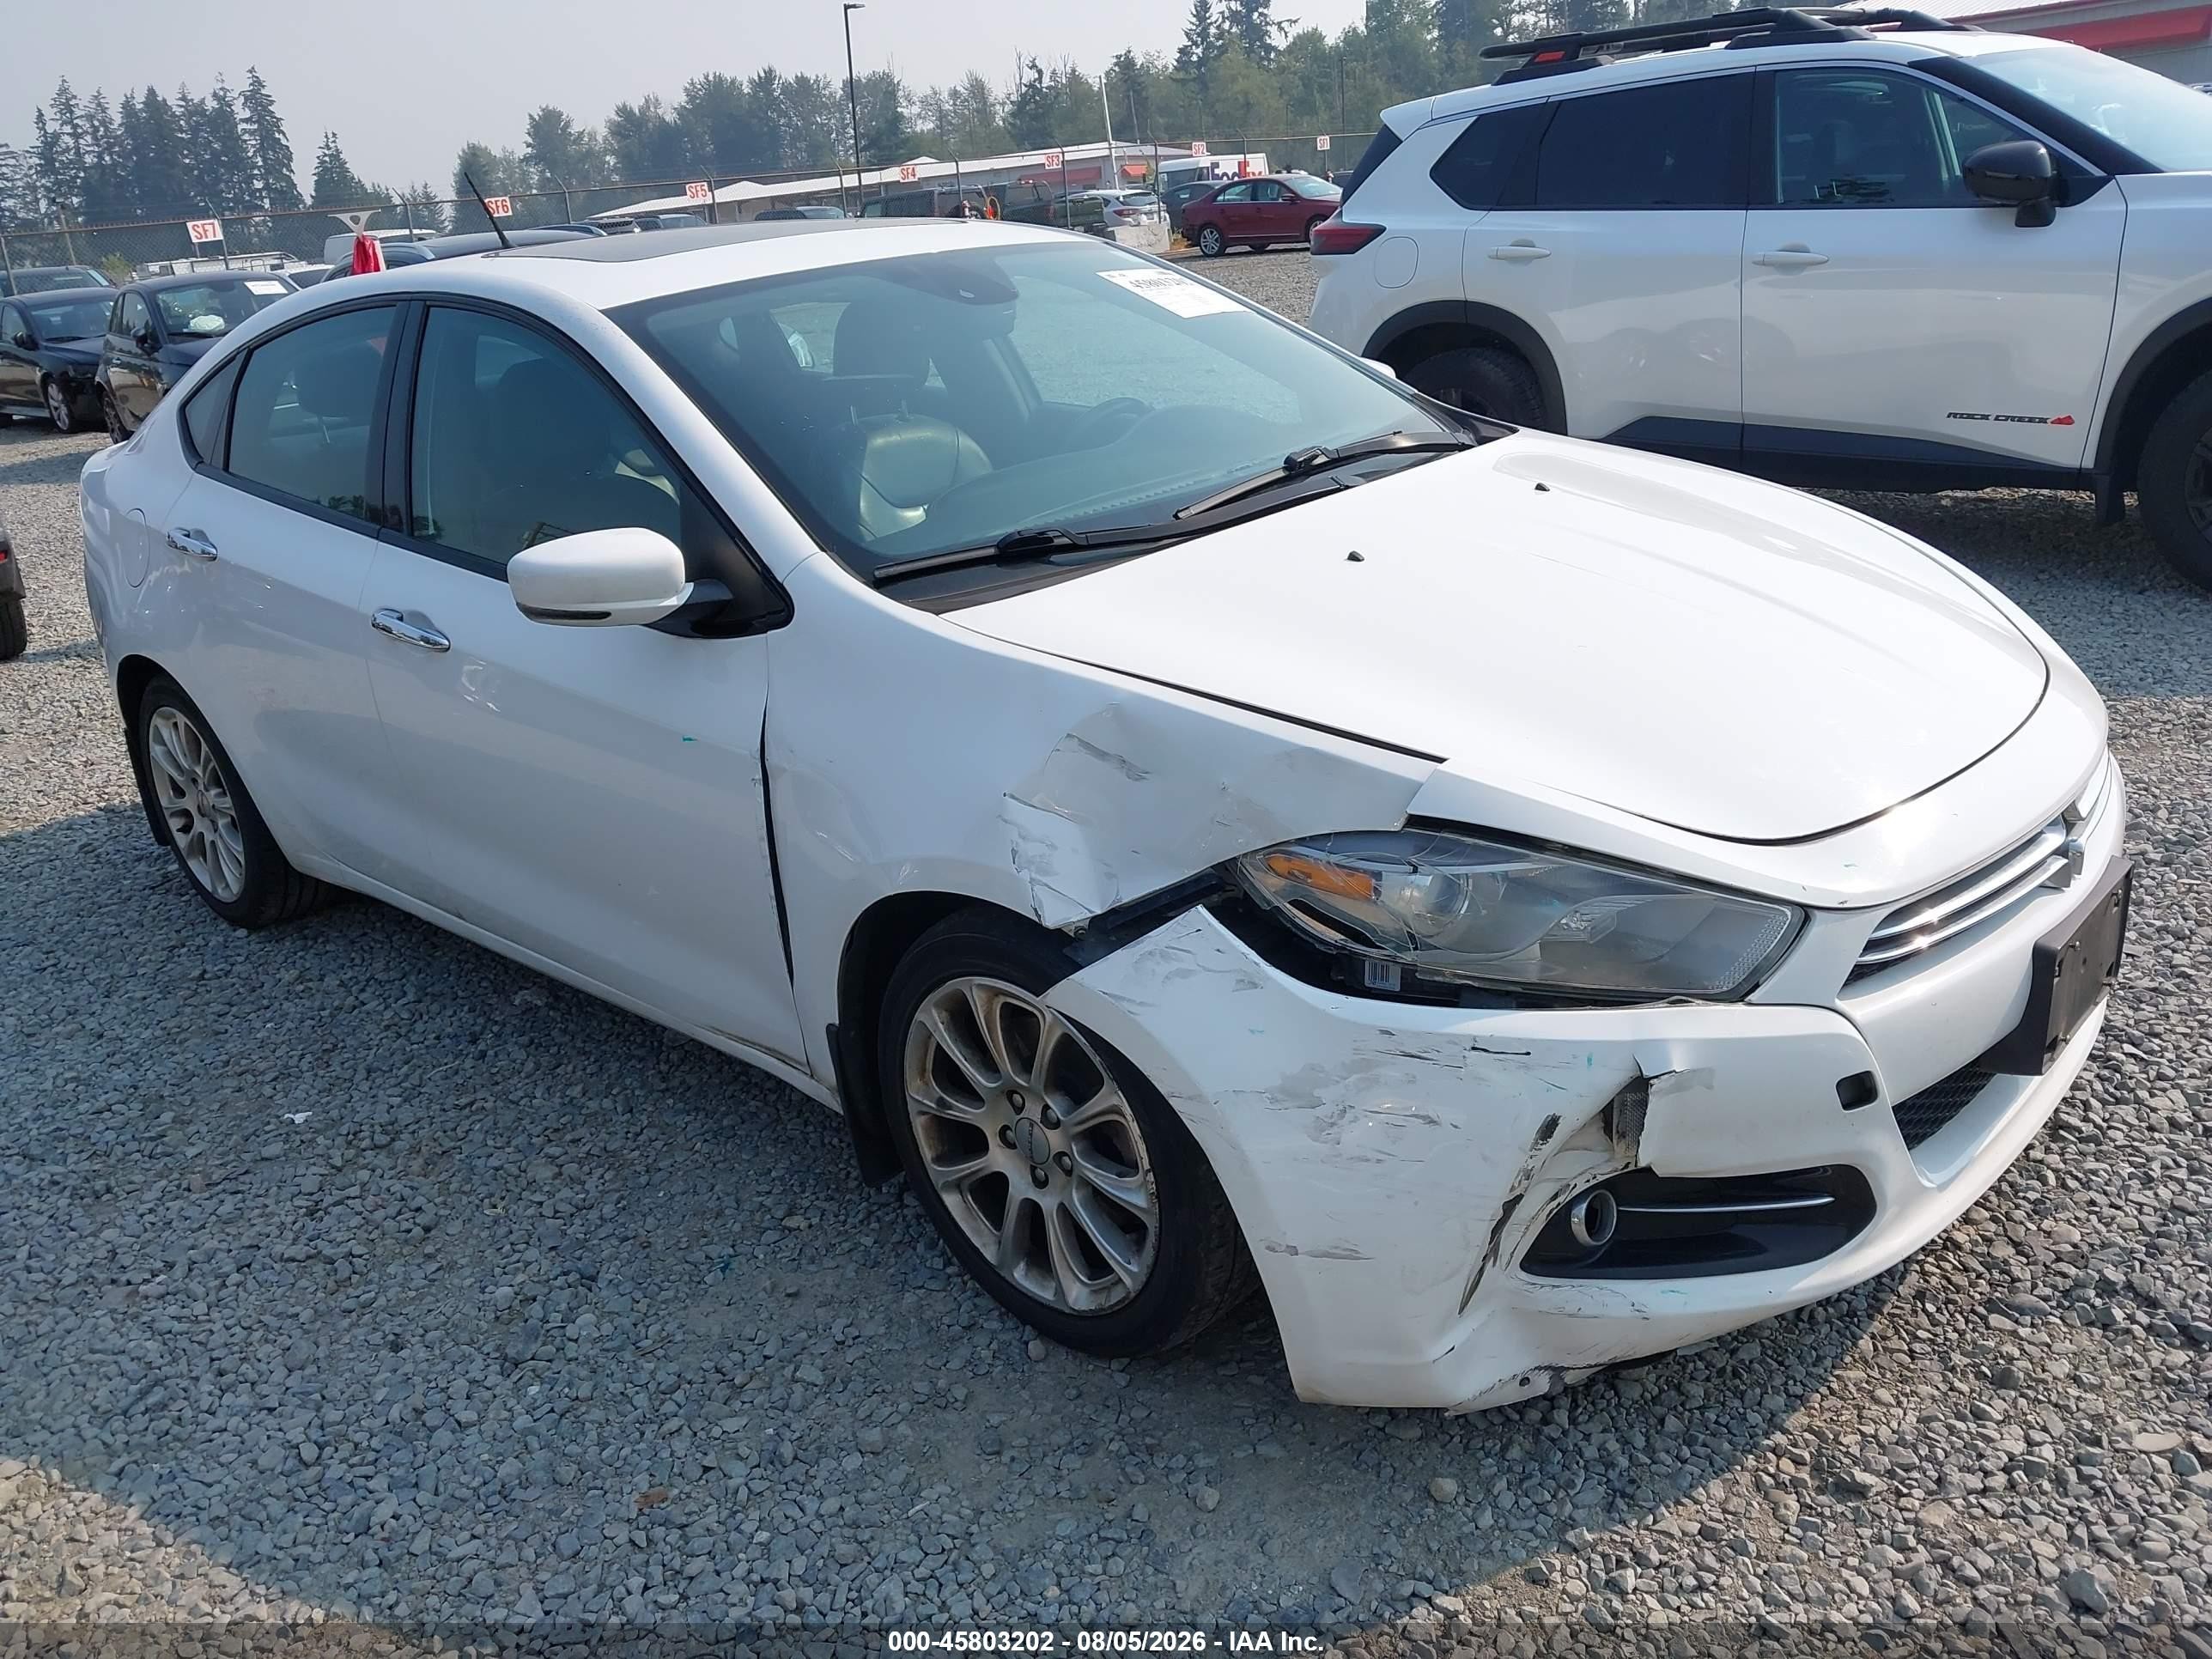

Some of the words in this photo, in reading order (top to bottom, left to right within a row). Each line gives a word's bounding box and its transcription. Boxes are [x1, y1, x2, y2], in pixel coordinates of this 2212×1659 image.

[1193, 143, 1206, 155] SF2
[1318, 137, 1328, 149] SF1
[1046, 155, 1060, 167] SF3
[900, 165, 916, 180] SF4
[688, 184, 708, 198] SF5
[487, 199, 509, 215] SF6
[191, 222, 216, 240] SF7
[1946, 411, 1992, 421] ROCK
[1993, 415, 2051, 424] CREEK
